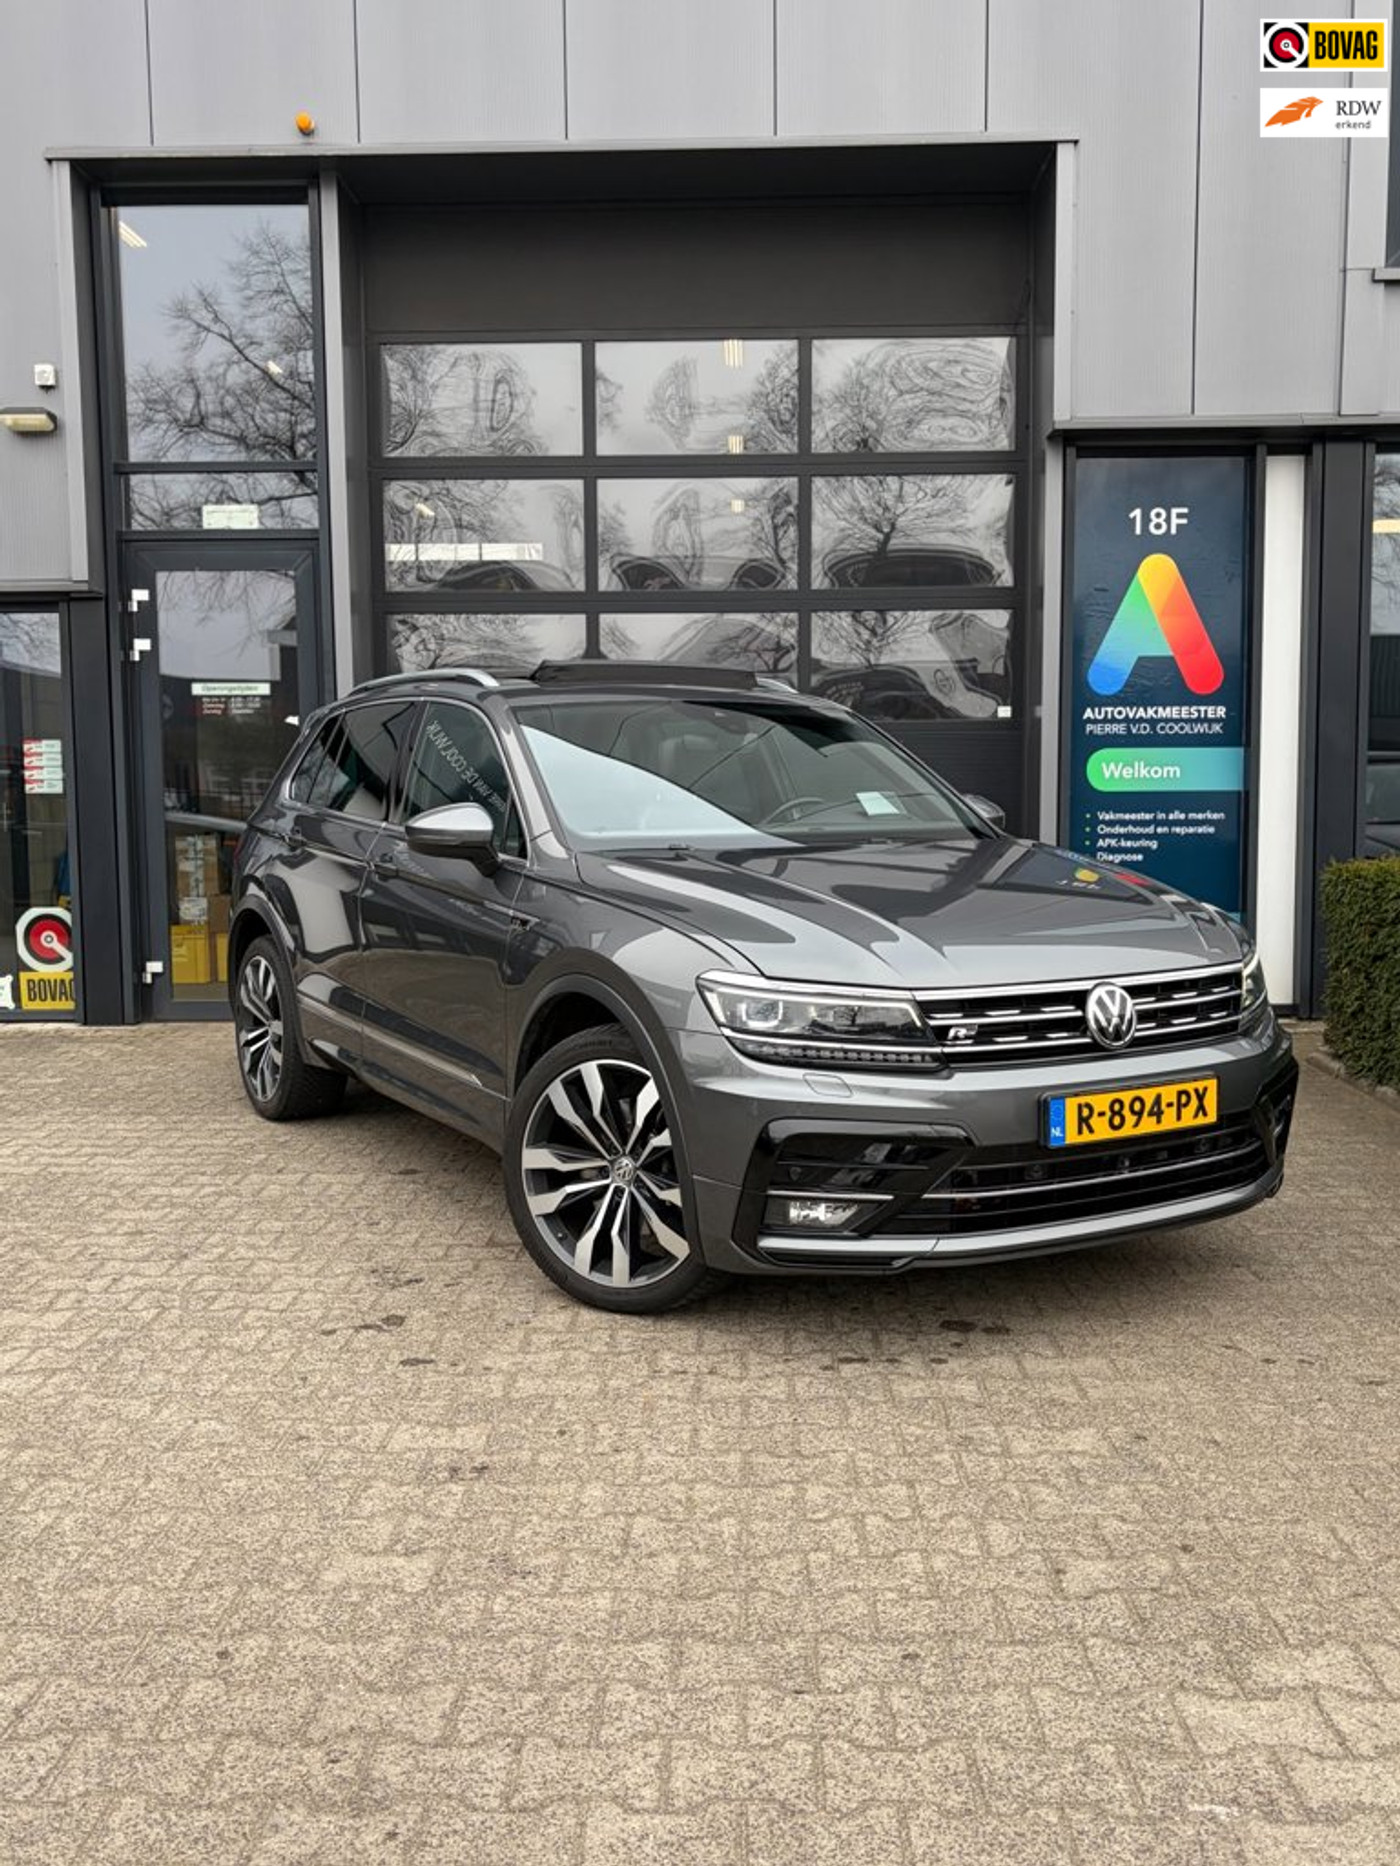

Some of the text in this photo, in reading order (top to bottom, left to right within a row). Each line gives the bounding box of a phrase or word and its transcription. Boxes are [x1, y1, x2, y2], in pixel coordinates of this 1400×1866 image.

[1128, 507, 1189, 535] 18F
[1083, 705, 1226, 720] AUTOVAKMEESTER
[1085, 722, 1224, 735] PIERRE V.D. COOLWIJK
[1102, 761, 1181, 780] Welkom
[1097, 810, 1225, 821] Vakmeester in alle merken
[1097, 824, 1215, 836] Onderhoud en reparatie
[1096, 838, 1158, 850] APK-keuring
[1096, 852, 1144, 863] Diagnose
[1077, 1086, 1208, 1136] R-894-PX
[1051, 1126, 1064, 1137] NL
